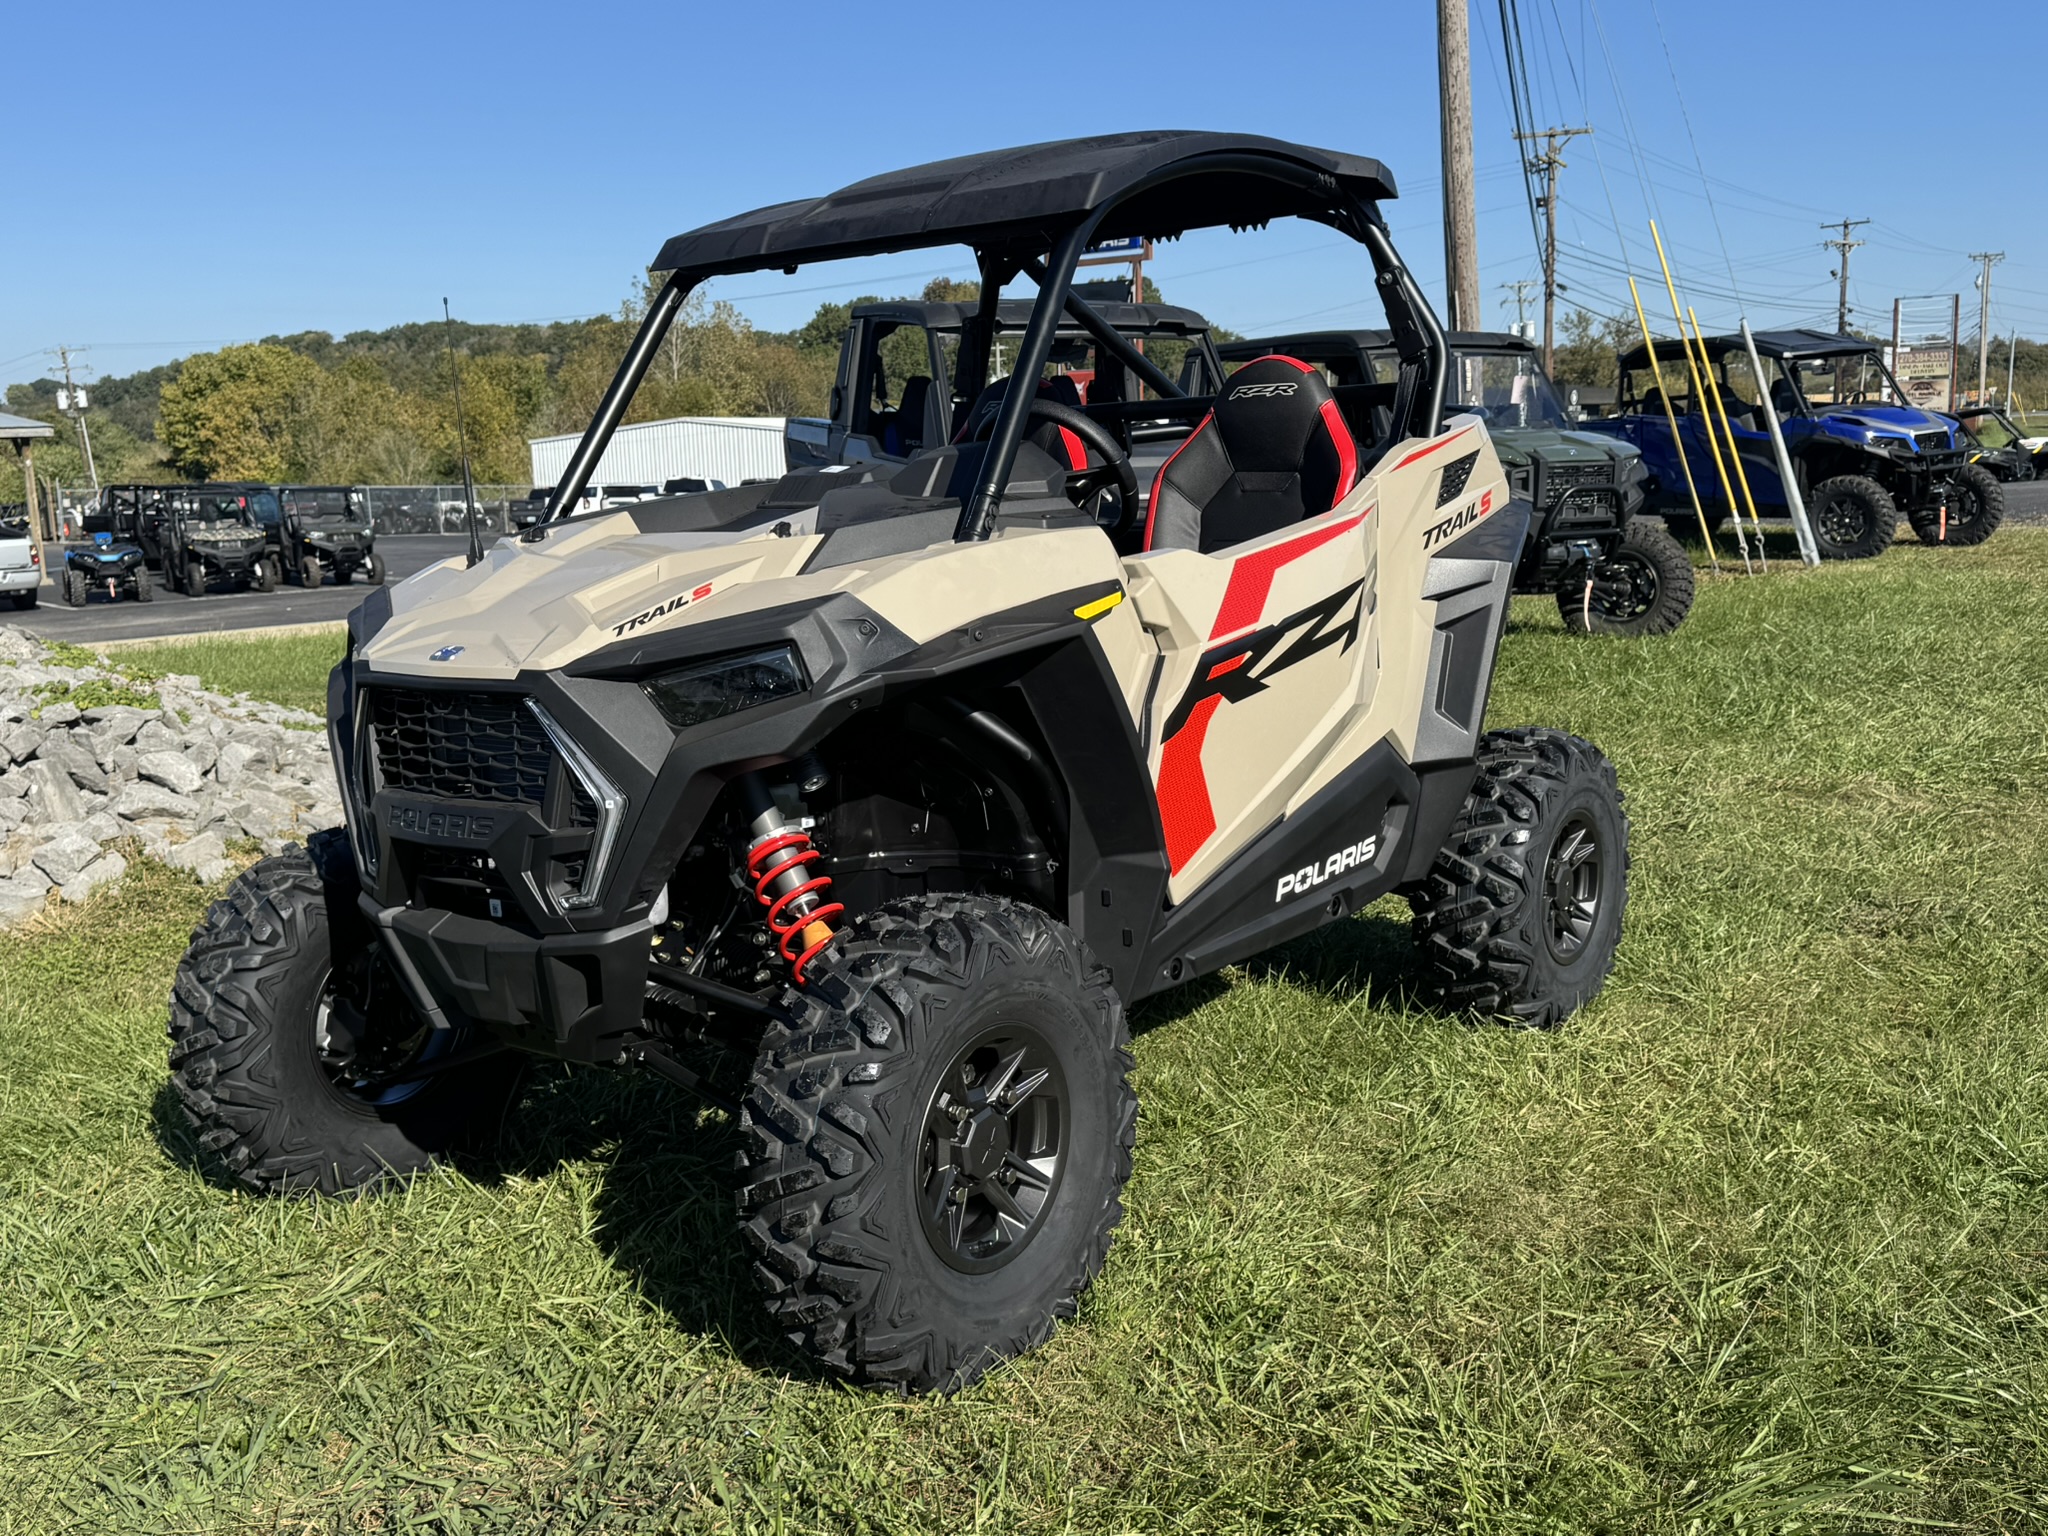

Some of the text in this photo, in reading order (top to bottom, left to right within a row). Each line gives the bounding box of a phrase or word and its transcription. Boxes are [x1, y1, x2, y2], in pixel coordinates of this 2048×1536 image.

[1899, 352, 1948, 363] 270-384-3333
[1228, 382, 1299, 400] RZR
[1422, 488, 1493, 550] TRAIL S
[613, 583, 713, 638] TRAIL S
[387, 805, 494, 840] POLARIS
[1275, 834, 1376, 902] POLARIS
